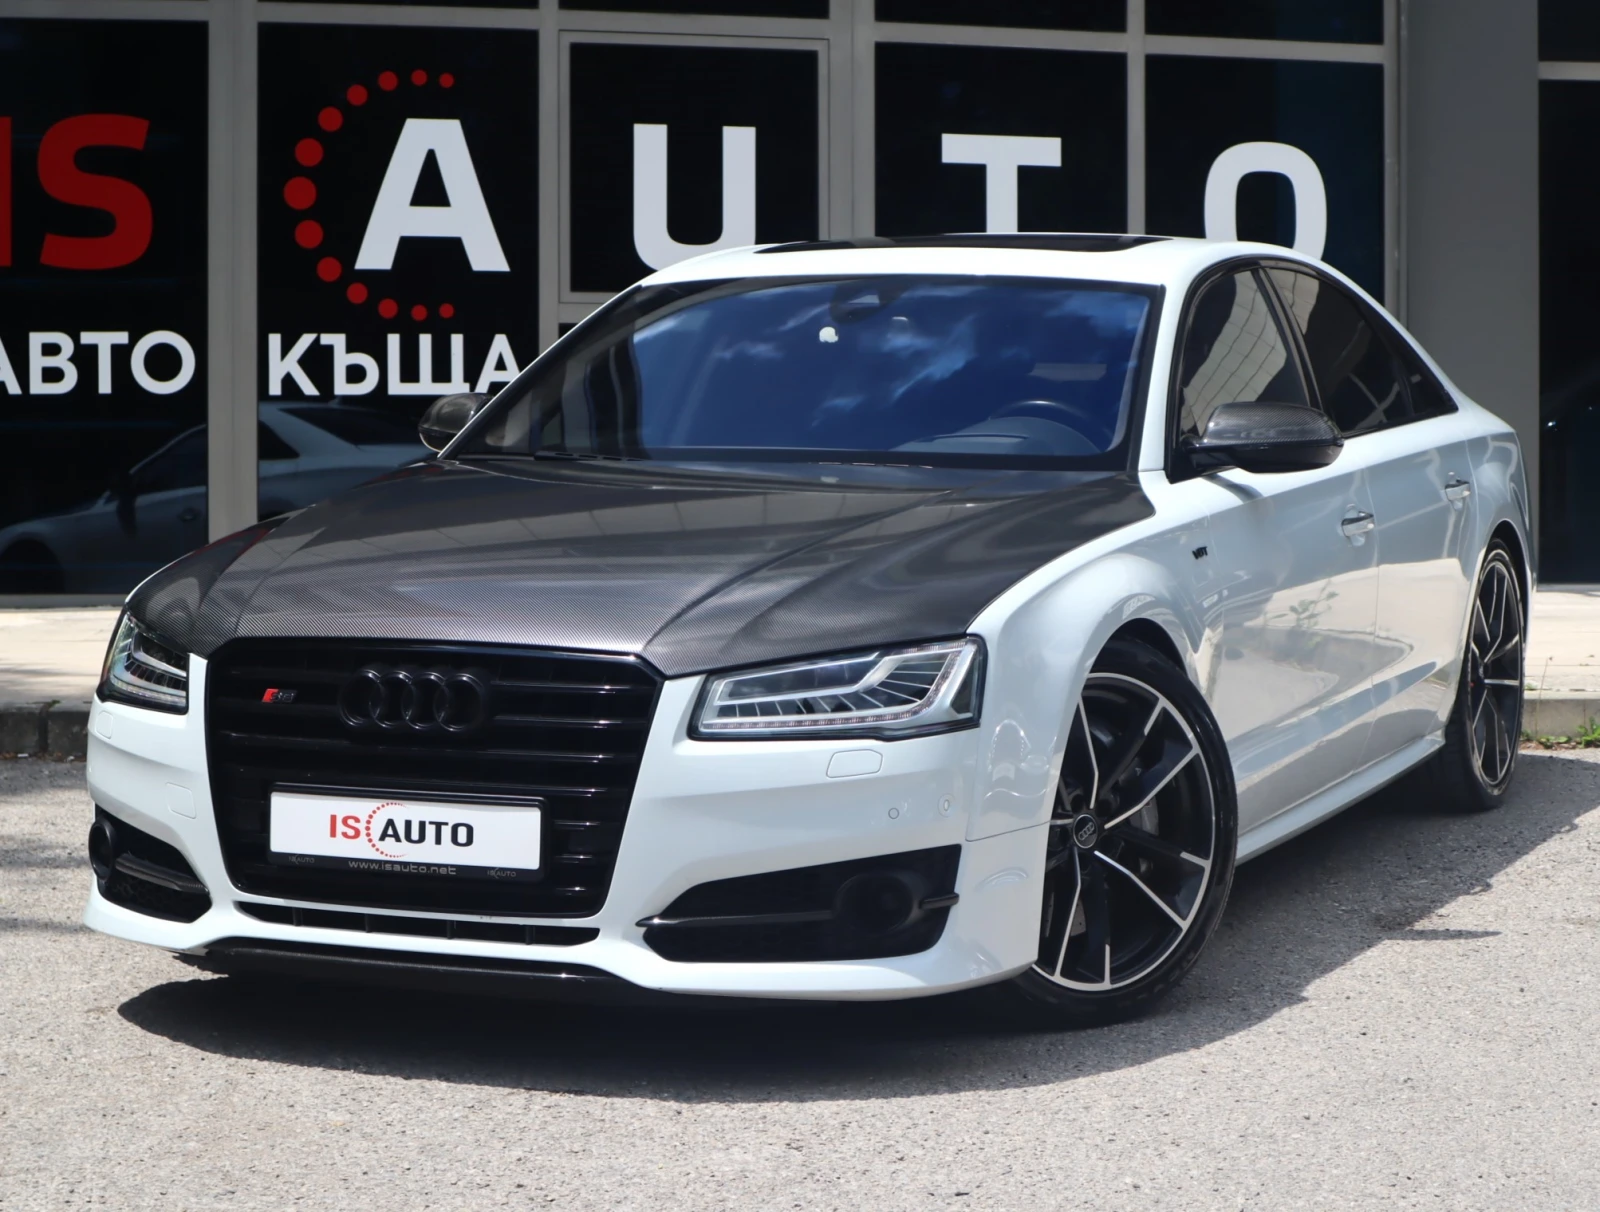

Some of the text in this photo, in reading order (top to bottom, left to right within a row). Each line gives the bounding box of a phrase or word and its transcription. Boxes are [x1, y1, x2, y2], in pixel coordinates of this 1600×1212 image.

[354, 118, 1327, 272] AUTO
[267, 333, 521, 396] КЪЩА
[329, 814, 474, 847] IS AUTO
[348, 860, 457, 875] www.isauto.net
